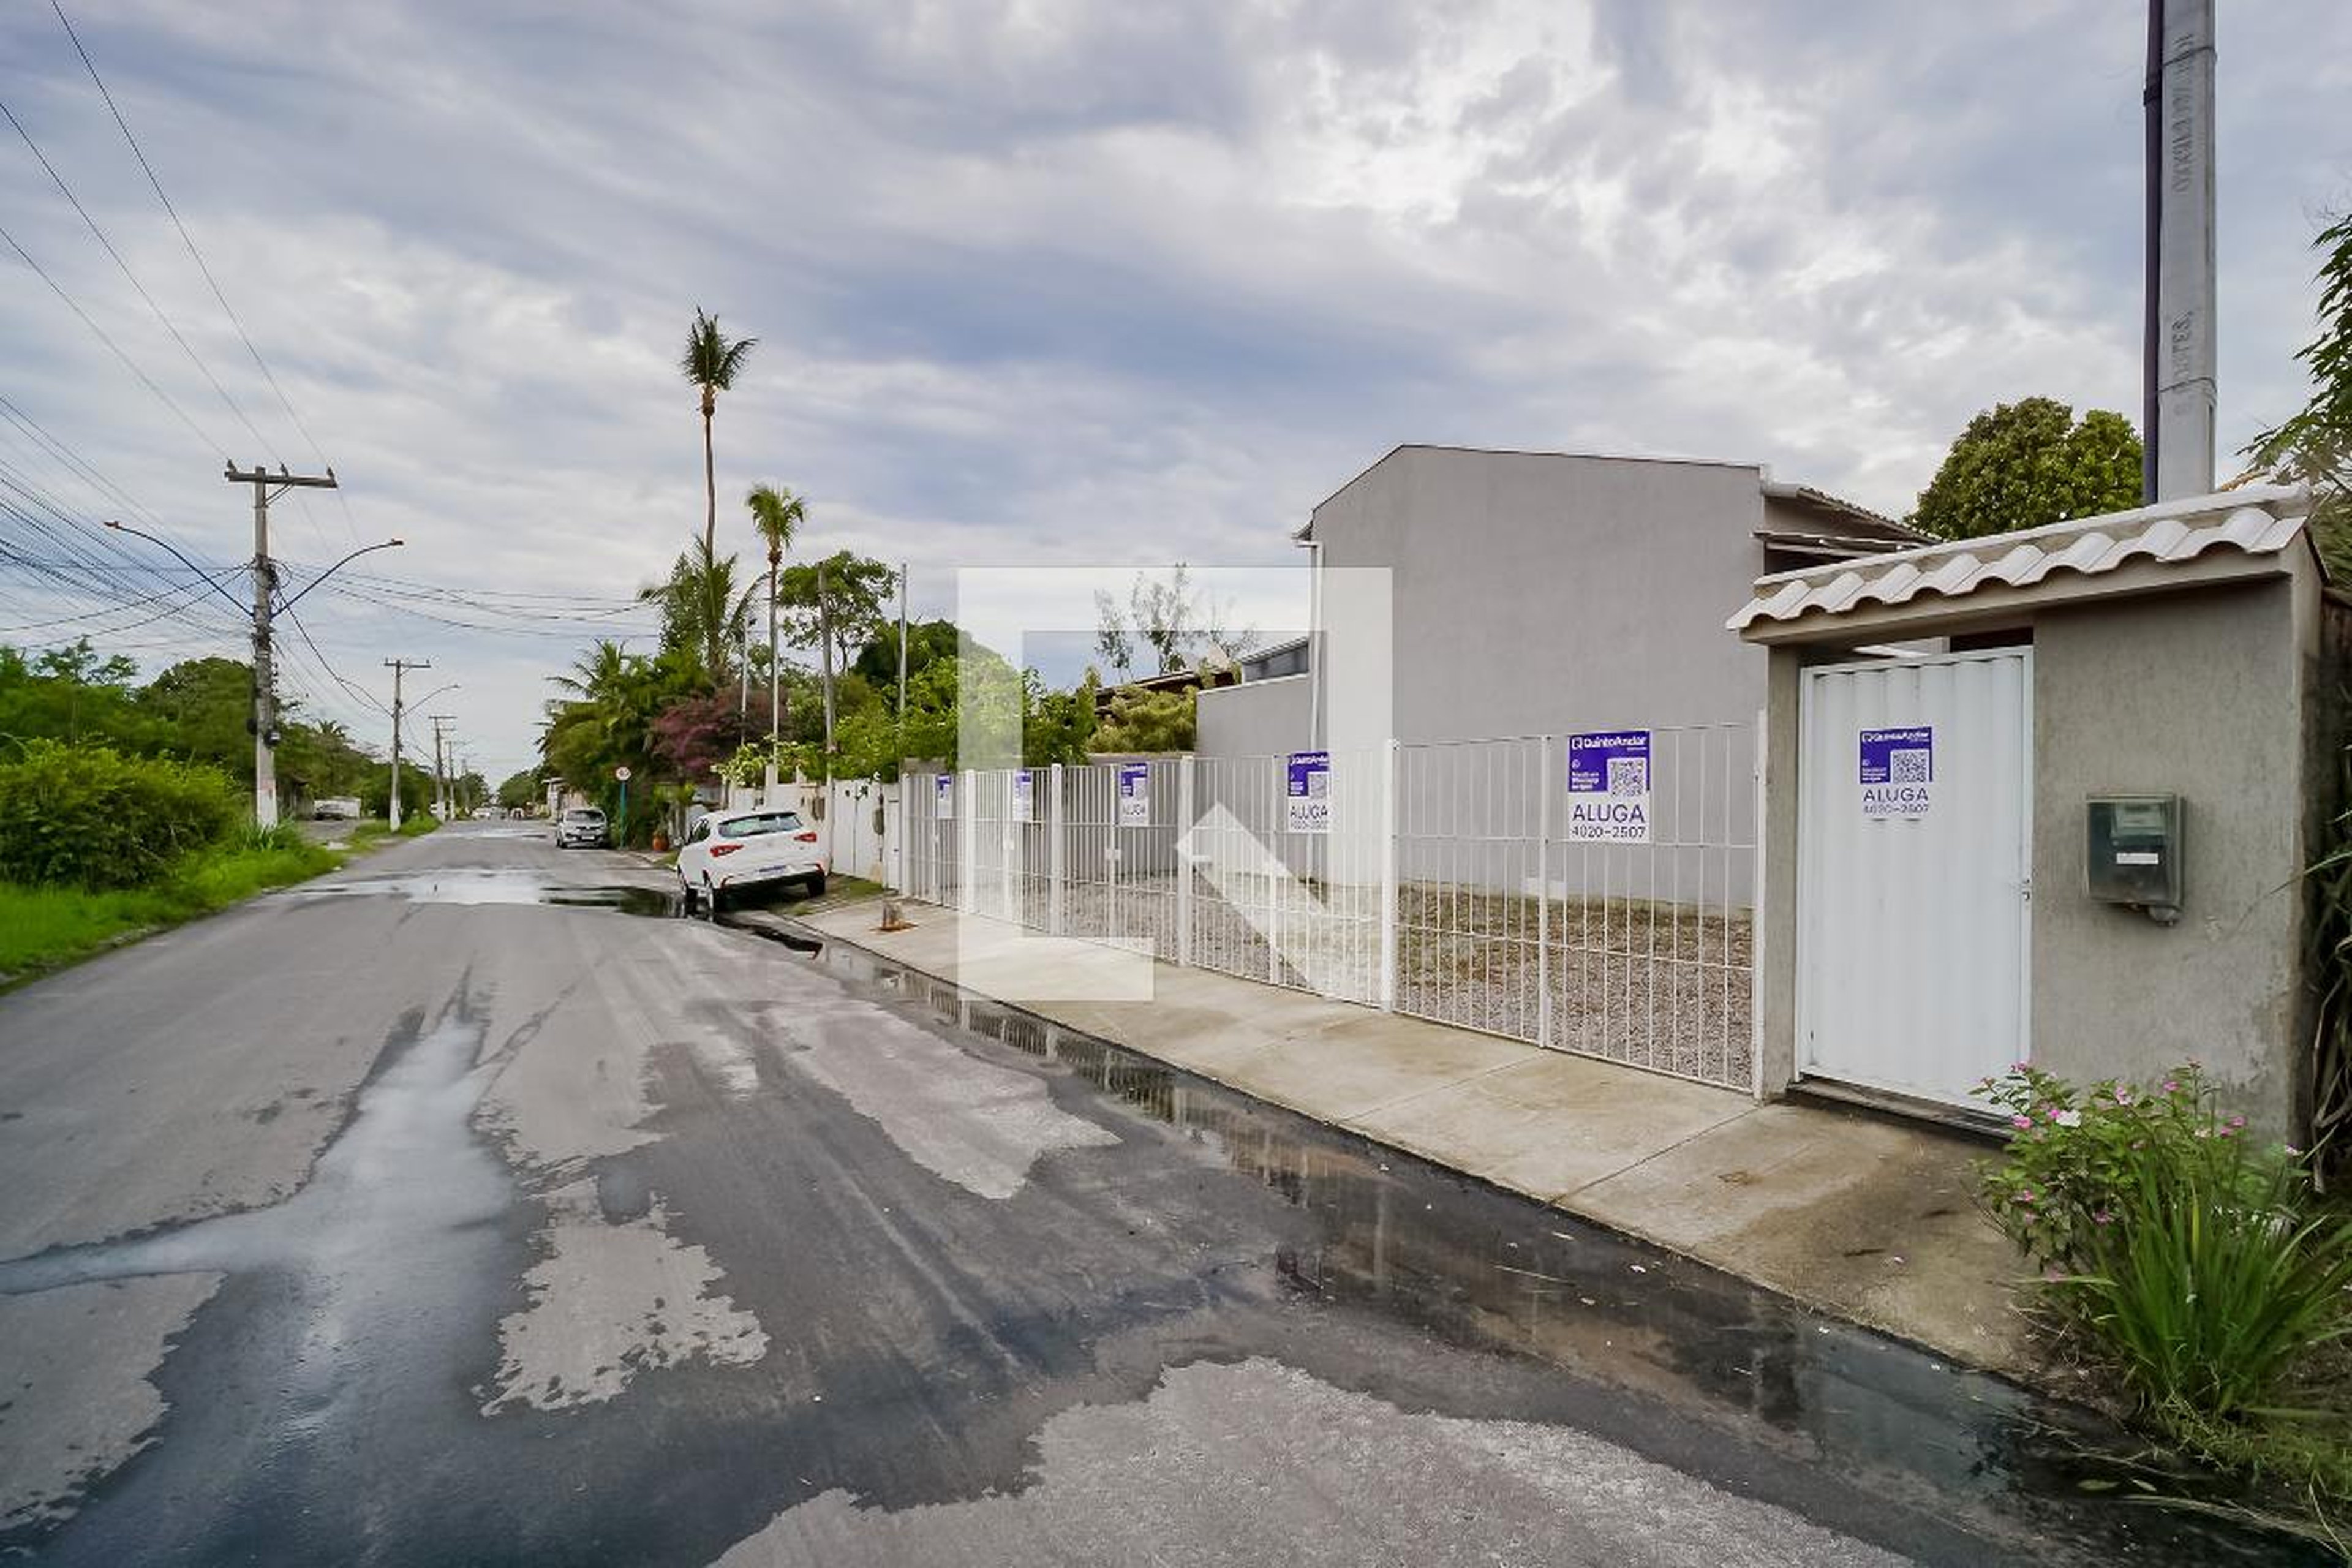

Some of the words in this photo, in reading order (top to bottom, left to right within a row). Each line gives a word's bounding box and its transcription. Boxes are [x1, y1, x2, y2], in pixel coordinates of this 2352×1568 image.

[1583, 736, 1648, 748] QuintoAndar
[1864, 787, 1929, 802] ALUGA
[1572, 804, 1645, 823] ALUGA
[1571, 824, 1646, 839] 4020-2507
